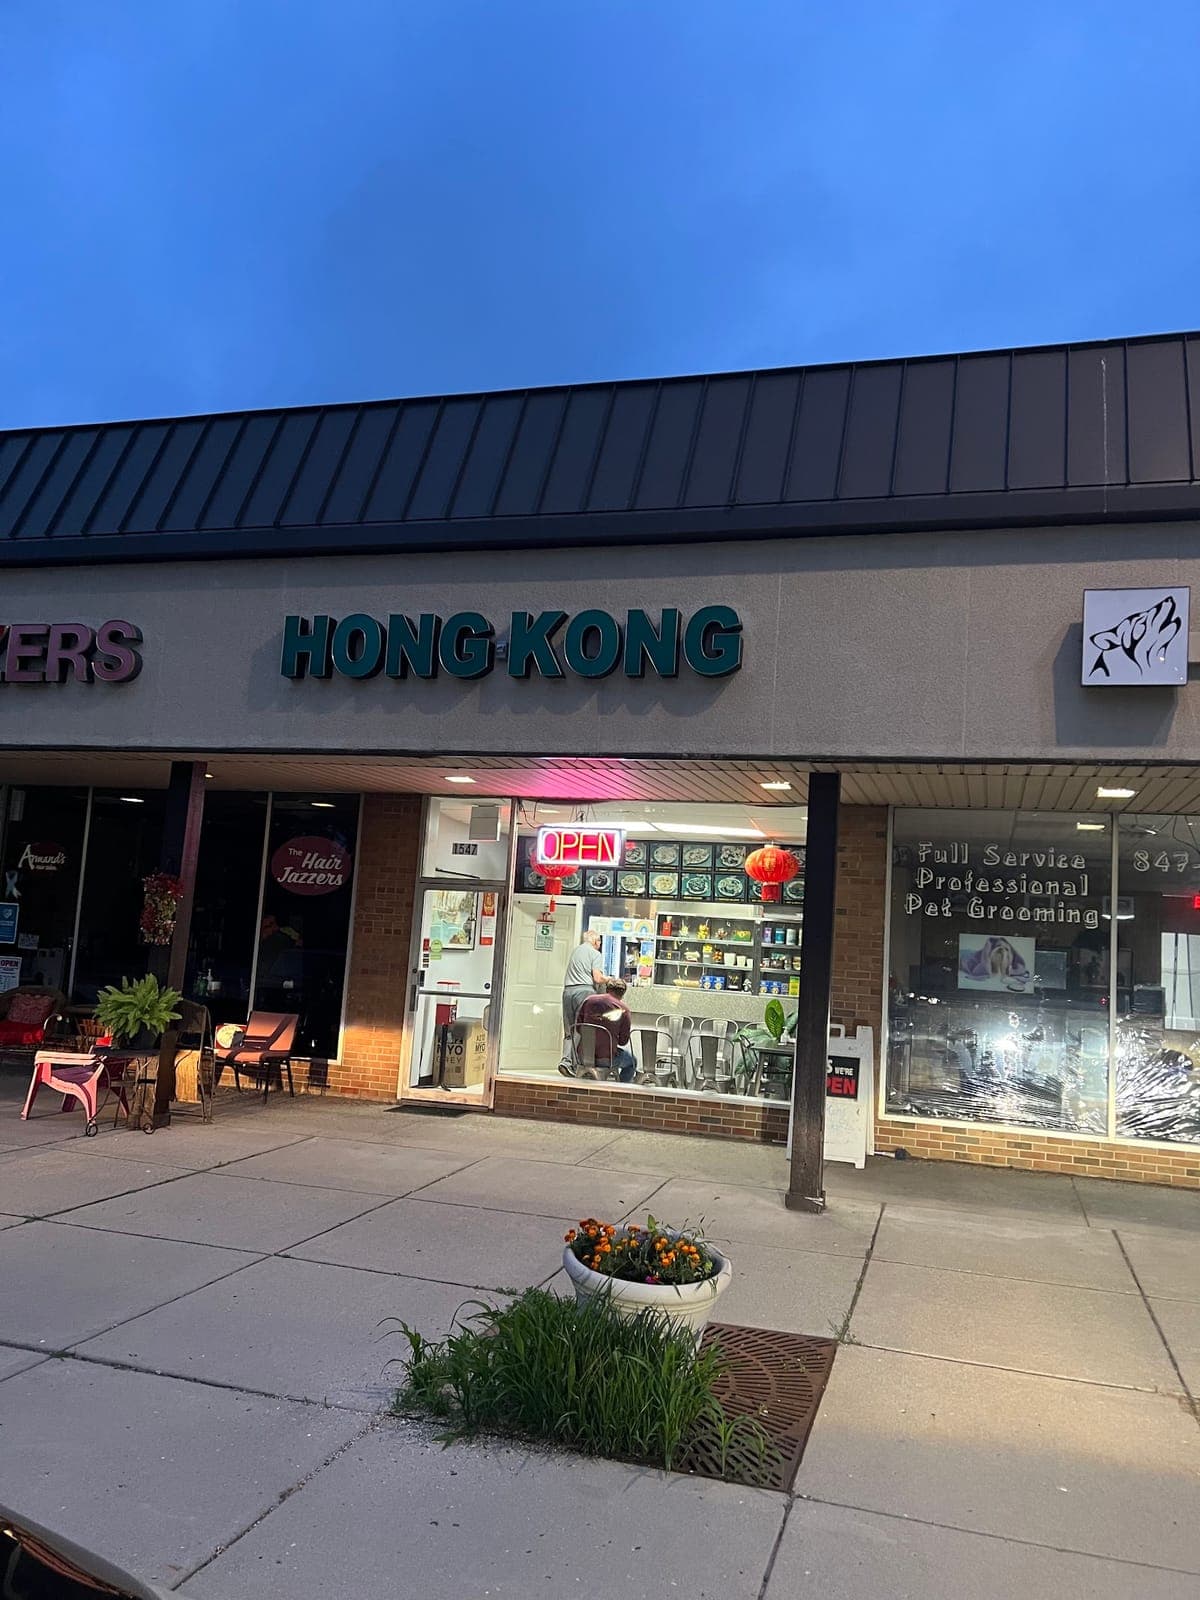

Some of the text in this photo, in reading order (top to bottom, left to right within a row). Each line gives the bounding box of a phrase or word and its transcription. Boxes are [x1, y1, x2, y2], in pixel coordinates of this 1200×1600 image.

[0, 619, 143, 684] ERS
[281, 605, 743, 679] HONG KONG
[288, 847, 343, 870] The Hair
[451, 843, 478, 856] 1547
[541, 830, 617, 863] OPEN
[918, 841, 1086, 869] Full Service
[276, 866, 343, 886] Jazzers
[915, 866, 1089, 897] Professional
[904, 892, 1099, 929] Pet Grooming
[541, 924, 550, 936] 5
[834, 1066, 854, 1076] WE'RE
